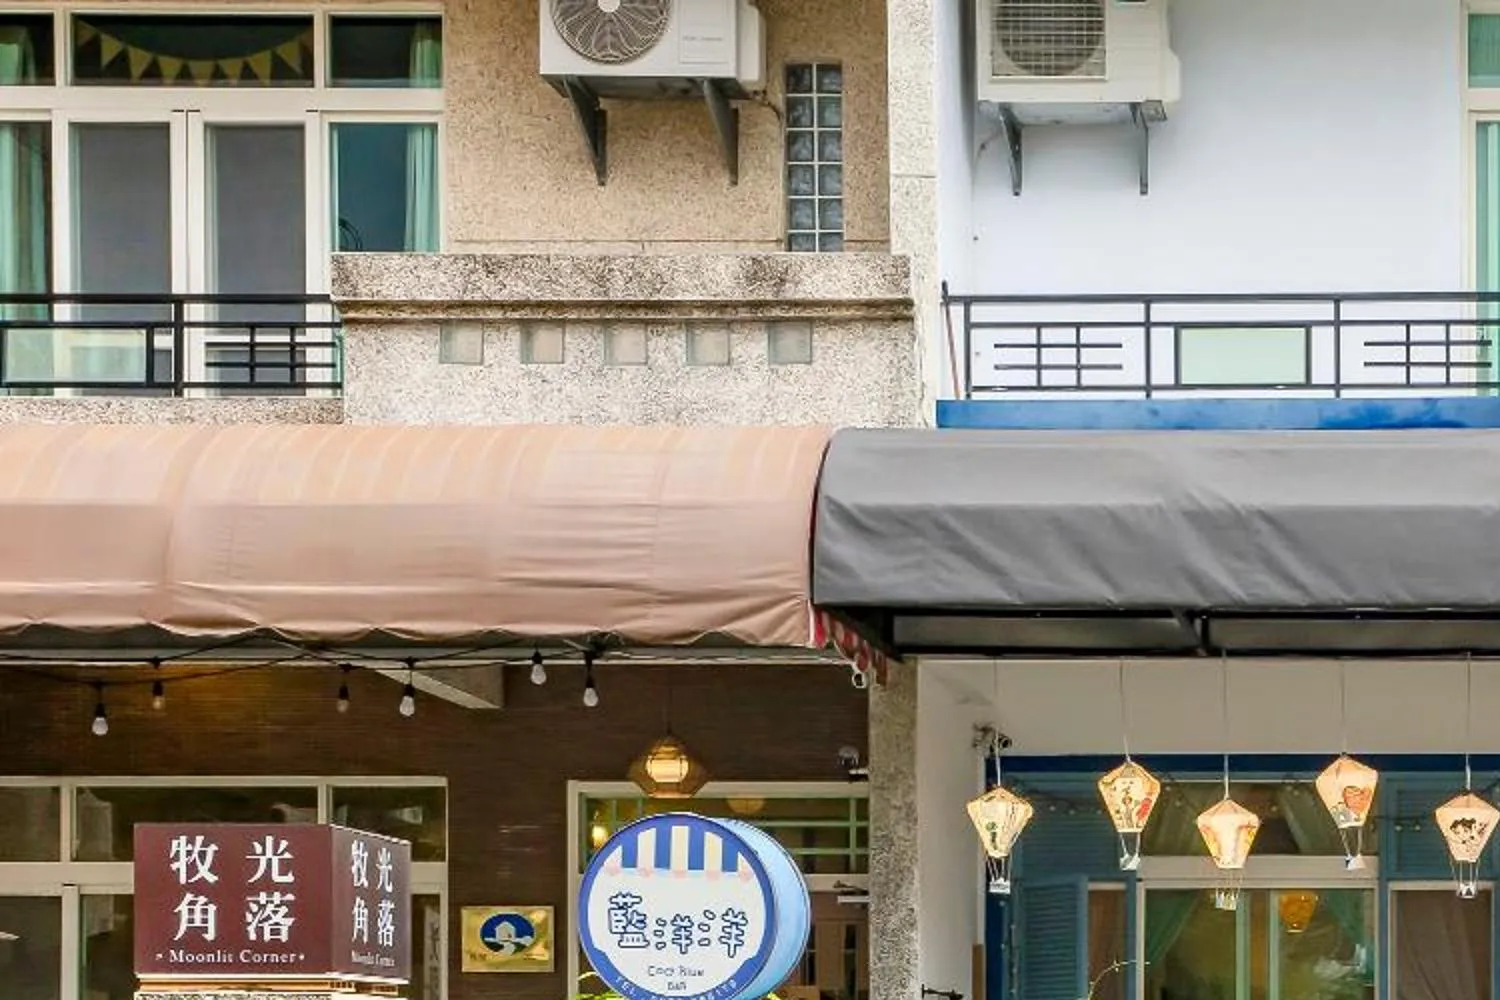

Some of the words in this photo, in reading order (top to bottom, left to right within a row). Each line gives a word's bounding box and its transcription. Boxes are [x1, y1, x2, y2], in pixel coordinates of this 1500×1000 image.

[169, 835, 295, 885] 牧光
[351, 840, 393, 893] 牧光
[173, 892, 295, 942] 角落
[351, 896, 395, 947] 角落
[608, 892, 748, 958] 藍洋洋
[169, 949, 233, 963] Moonlit
[239, 949, 297, 963] Corner
